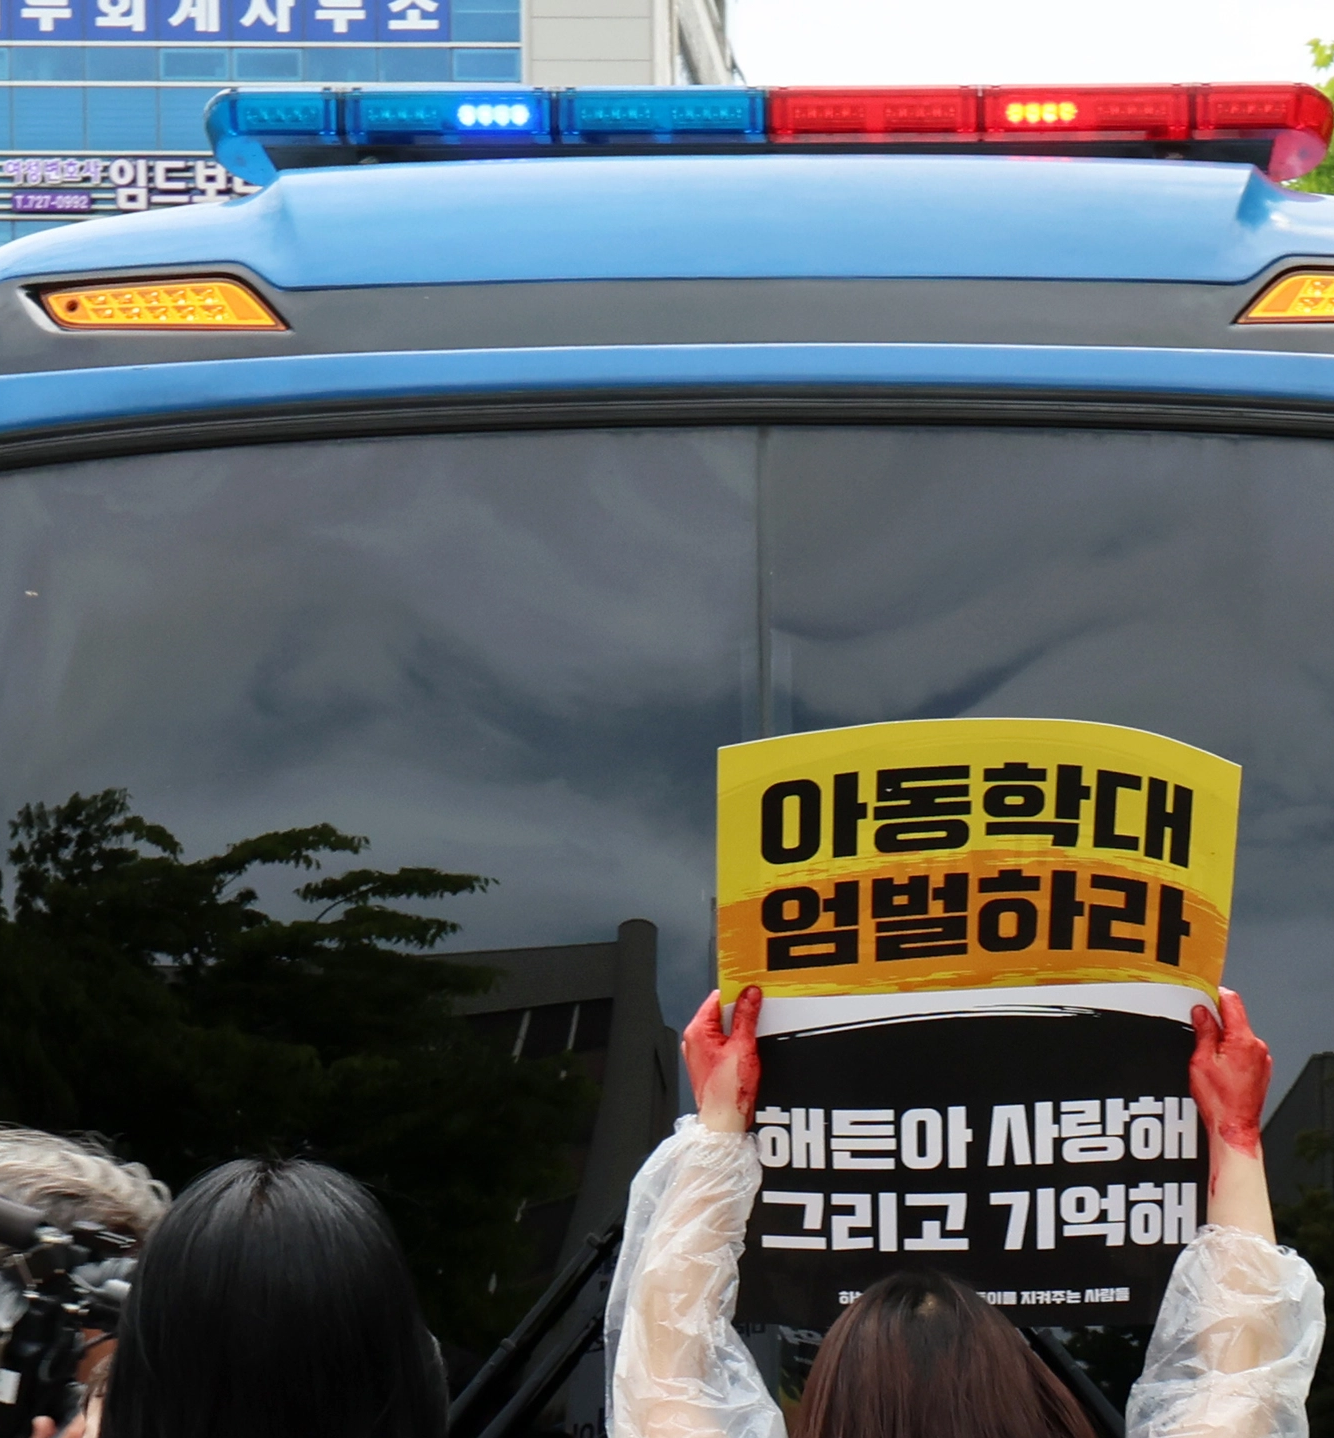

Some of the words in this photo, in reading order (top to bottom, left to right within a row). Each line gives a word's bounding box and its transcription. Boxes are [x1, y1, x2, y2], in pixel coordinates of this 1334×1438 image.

[760, 762, 1194, 868] 아동학대
[761, 869, 1191, 972] 엄벌하라
[755, 1105, 973, 1170] 해든아
[987, 1096, 1198, 1168] 사랑해
[761, 1191, 968, 1252] 그리고
[989, 1182, 1198, 1250] 기억해
[1020, 1288, 1081, 1305] 지켜주는
[1084, 1286, 1130, 1303] 사람들
